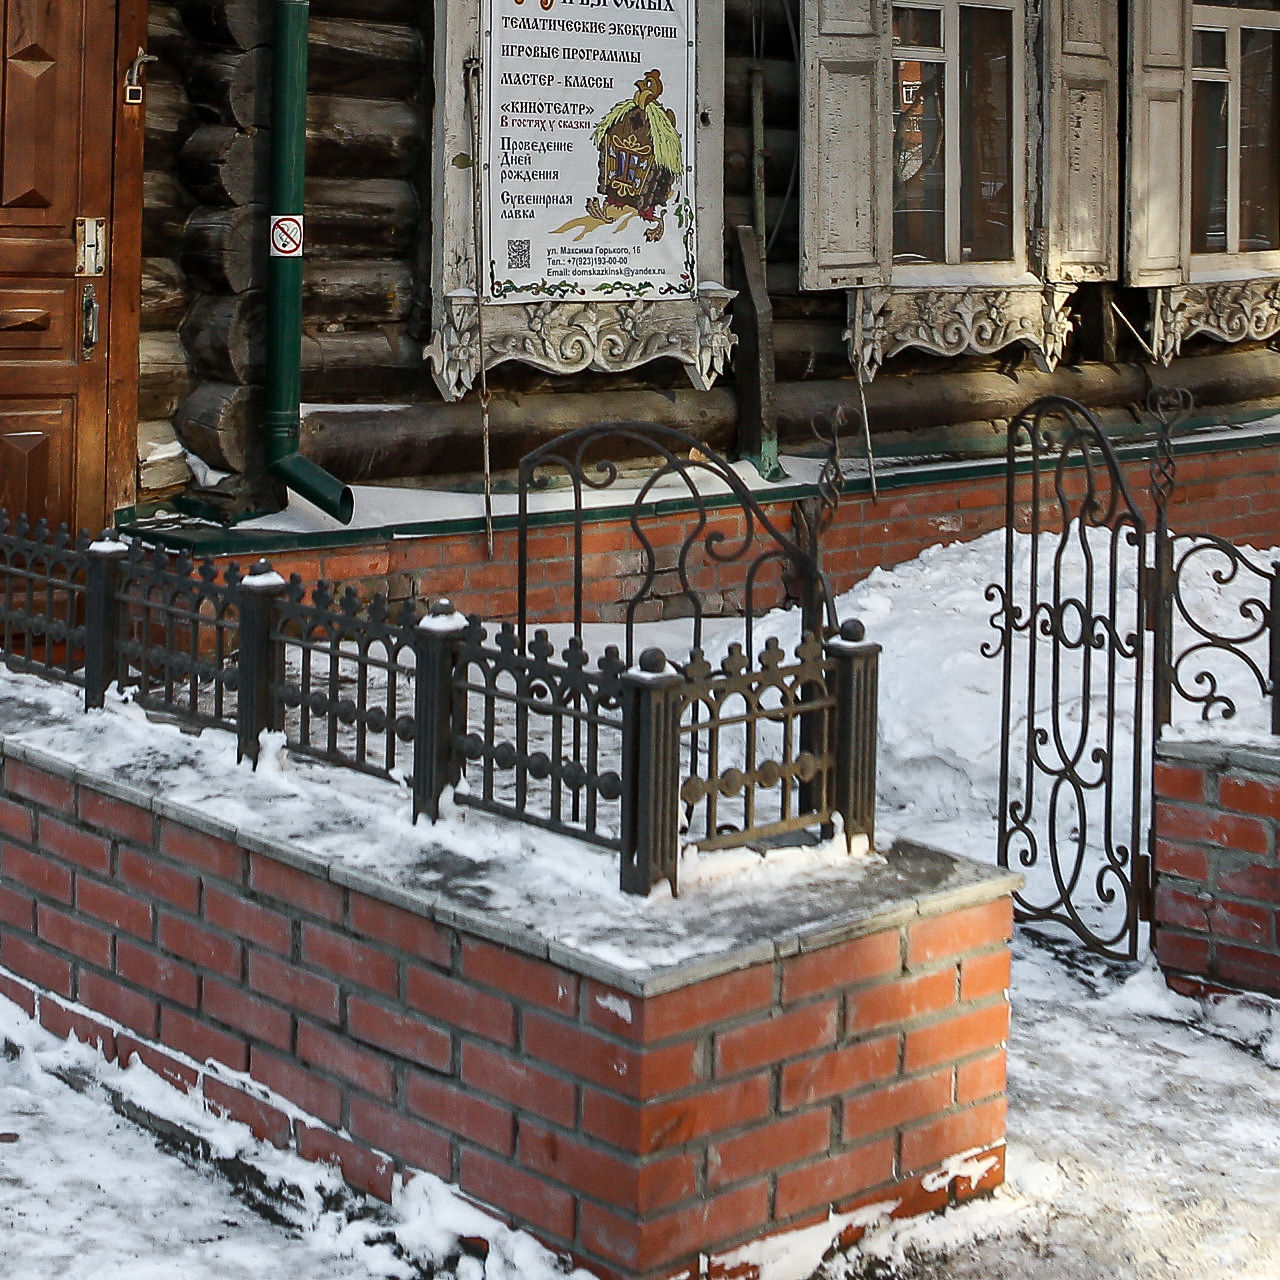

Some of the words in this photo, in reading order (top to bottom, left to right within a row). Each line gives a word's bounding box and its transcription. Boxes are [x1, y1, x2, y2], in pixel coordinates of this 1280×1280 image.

[501, 16, 607, 34] ТЕМАТИЧЕСКИЕ
[608, 22, 678, 39] ЭКСКУРСИИ
[501, 44, 560, 59] ИГРОВЫЕ
[562, 47, 641, 64] ПРОГРАММЫ
[500, 73, 555, 87] МАСТЕР
[564, 75, 614, 89] КЛАССЫ
[500, 101, 595, 115] «КИНОТЕАТР»
[500, 115, 509, 128] В
[511, 118, 547, 132] гостях
[549, 119, 556, 132] у
[557, 120, 591, 130] сказки
[500, 136, 574, 155] Проведение
[500, 151, 532, 168] Дней
[500, 169, 559, 184] рождения
[500, 190, 573, 209] Сувенирная
[500, 209, 536, 220] лавка
[546, 247, 559, 257] ул.
[560, 246, 594, 255] Максима
[595, 246, 631, 257] Горького,
[633, 245, 641, 255] 16
[567, 256, 628, 267] +7(923)193-00-00
[546, 268, 571, 277] Email:
[572, 267, 666, 277] domskazkinsk@yandex.ru
